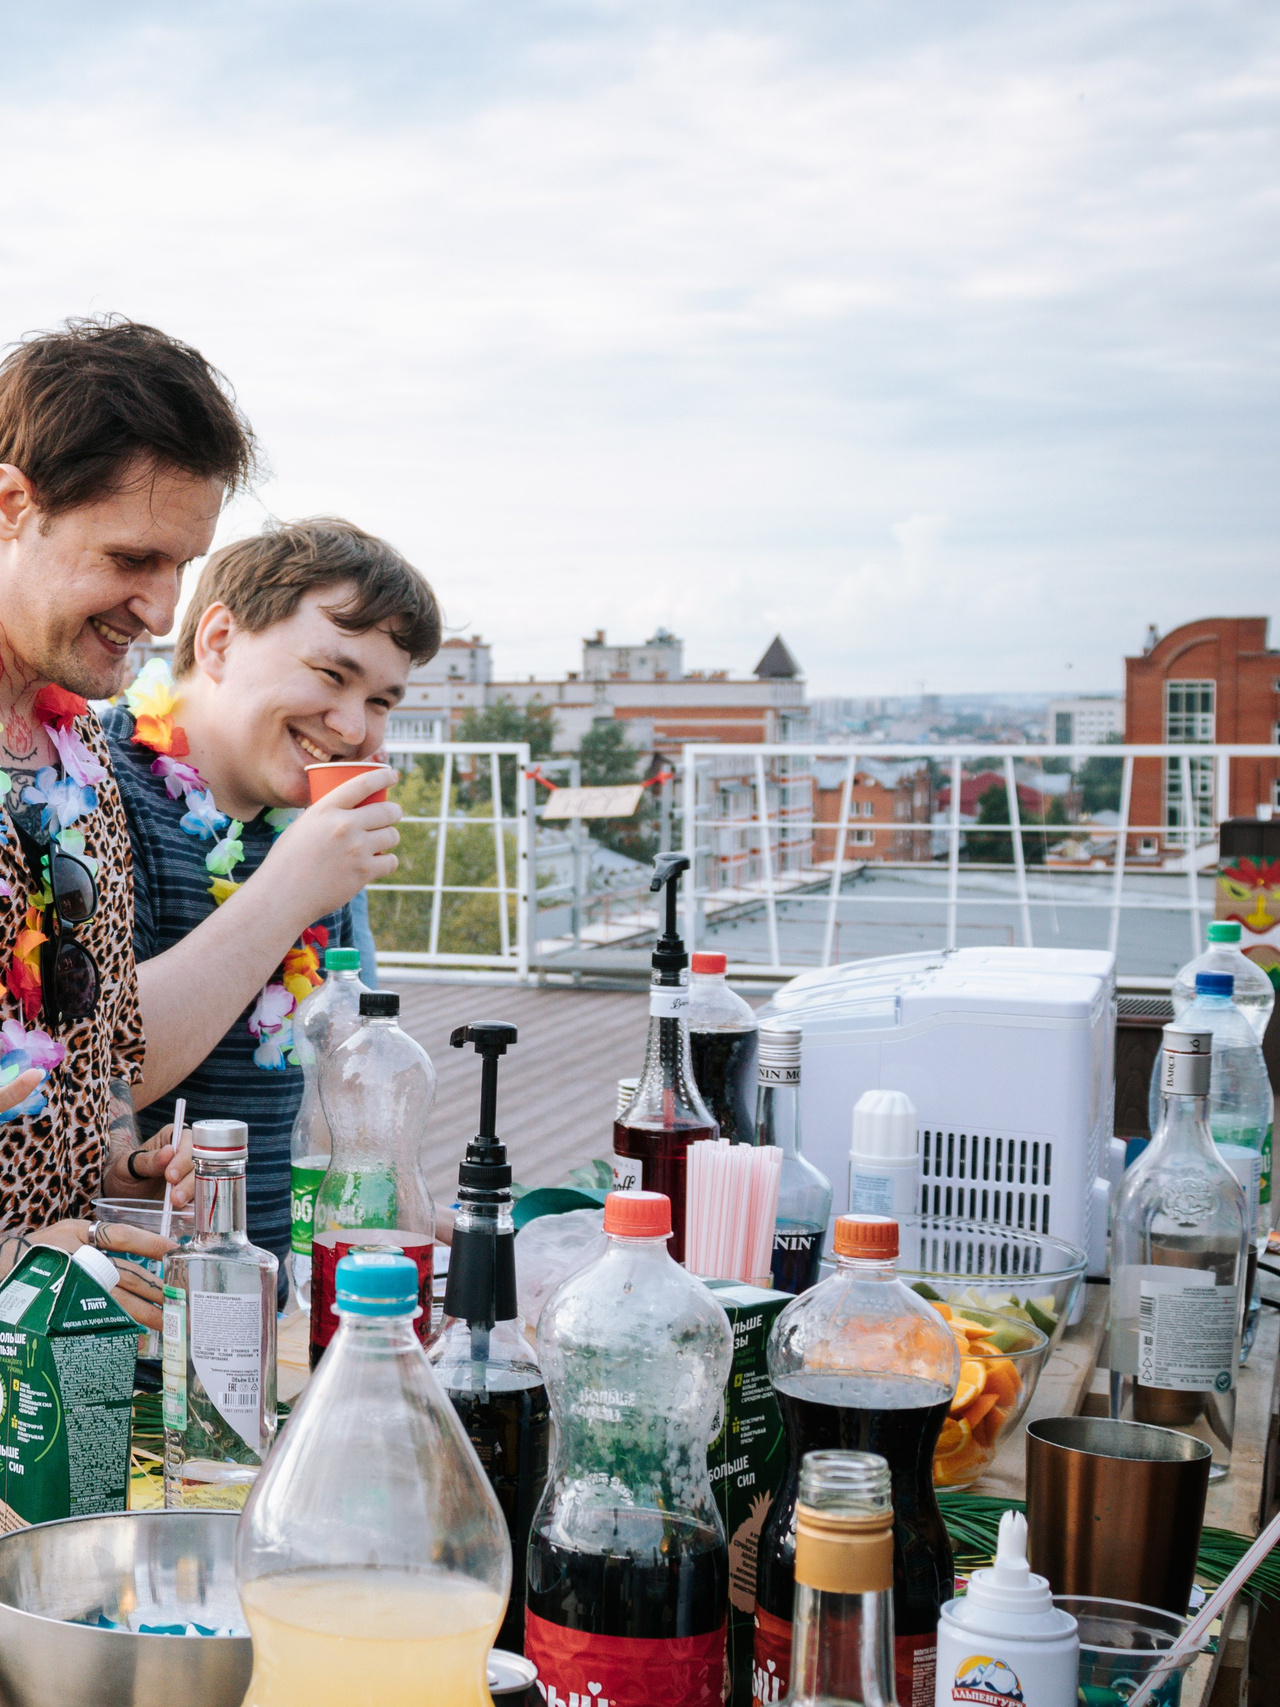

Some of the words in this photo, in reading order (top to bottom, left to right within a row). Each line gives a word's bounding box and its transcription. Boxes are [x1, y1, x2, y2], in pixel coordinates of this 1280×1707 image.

[87, 1301, 108, 1310] ЛИТР
[9, 1461, 25, 1475] СИЛ
[708, 1454, 749, 1483] БОЛЬШЕ
[737, 1472, 756, 1488] СИЛ
